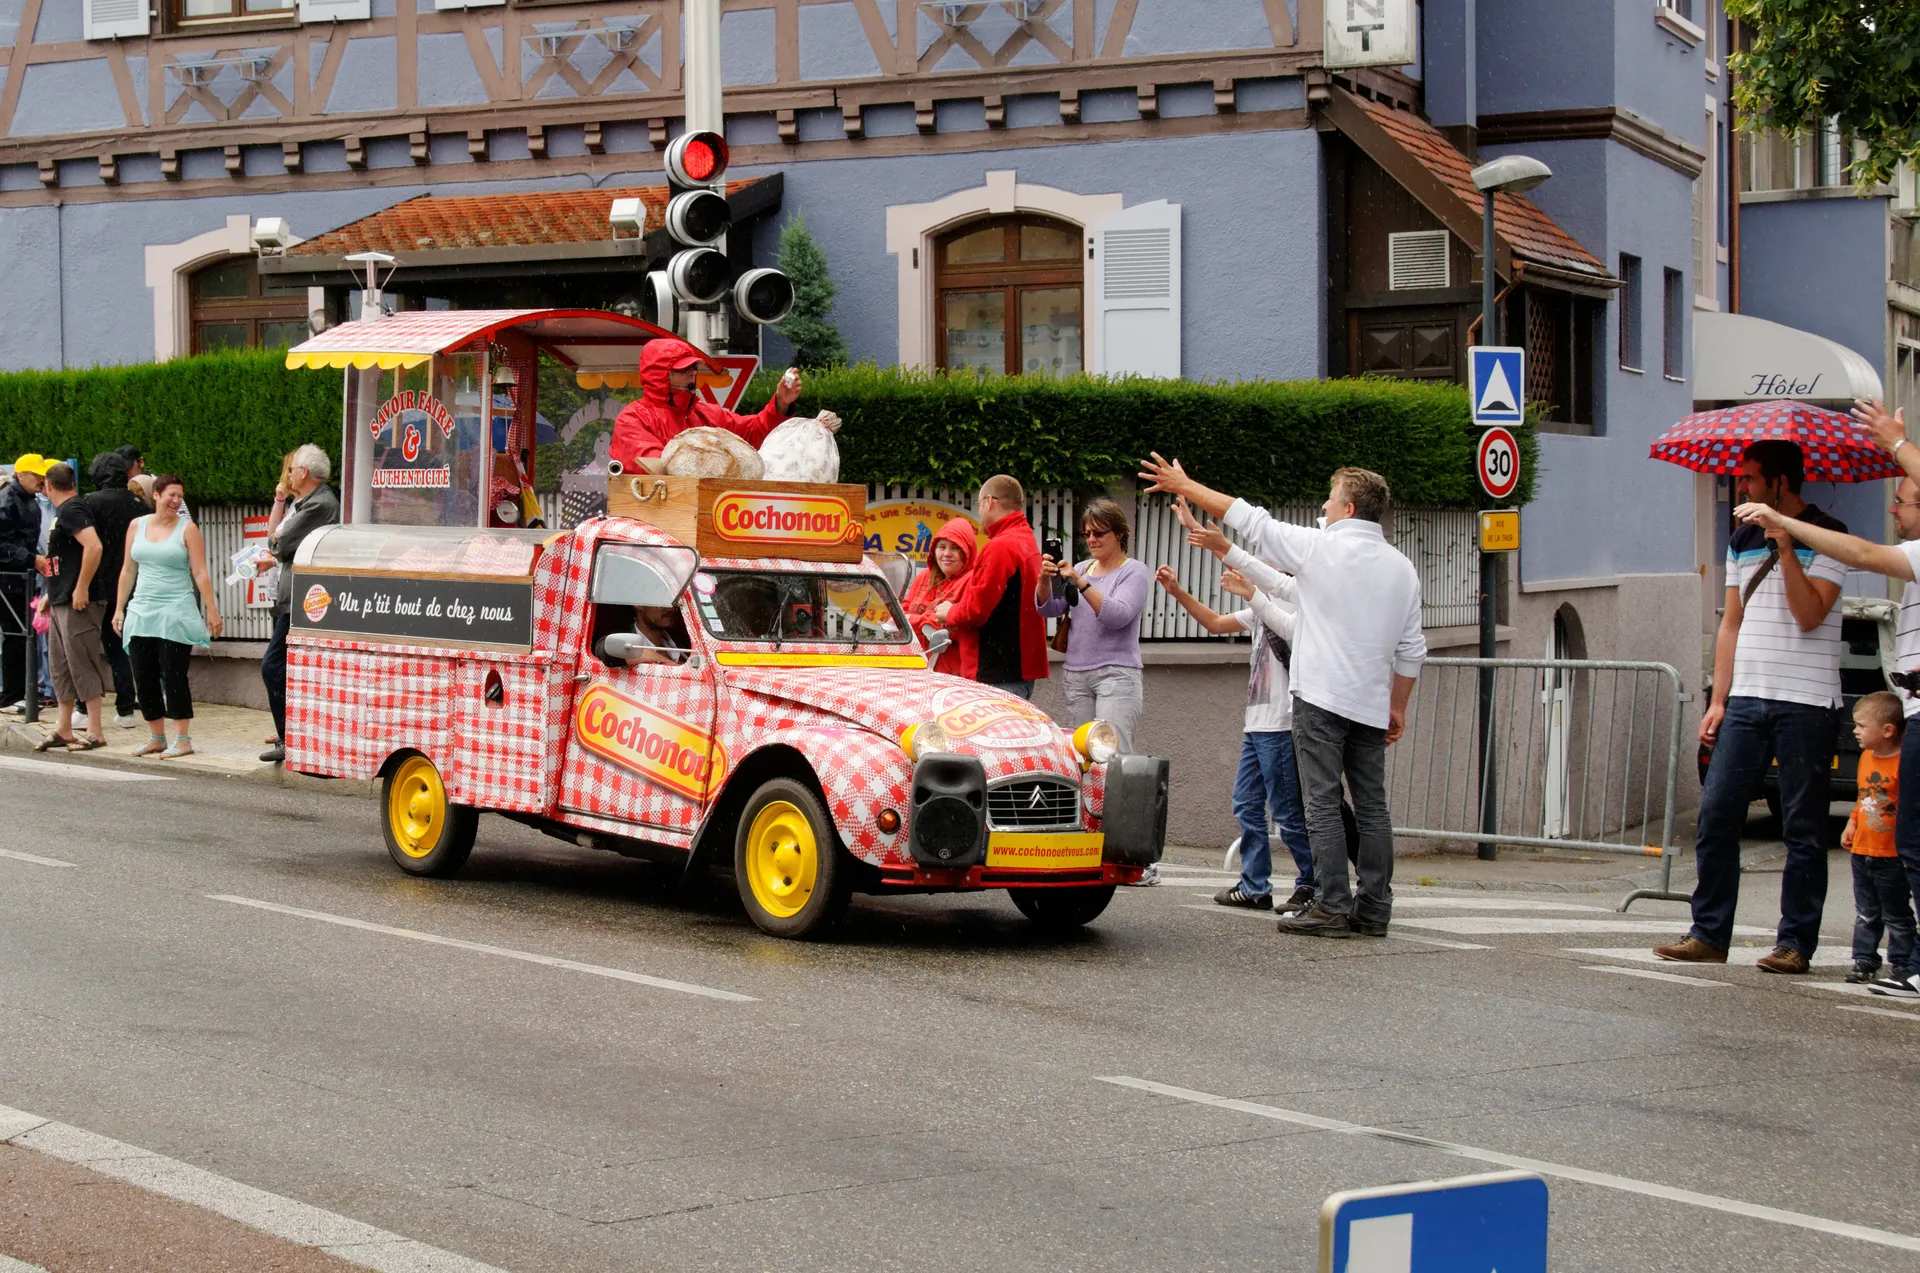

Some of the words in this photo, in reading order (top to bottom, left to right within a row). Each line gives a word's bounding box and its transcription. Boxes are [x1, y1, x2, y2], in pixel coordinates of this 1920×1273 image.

[1744, 373, 1823, 396] Hôtel
[370, 390, 415, 440] SAVOIR
[417, 390, 456, 440] FAIRE
[402, 424, 421, 462] &
[371, 463, 450, 488] AUTHENTICITÉ
[1488, 448, 1511, 477] 30
[721, 503, 841, 533] Cochonou
[880, 508, 899, 519] une
[904, 505, 932, 517] Salle
[936, 510, 950, 521] de
[895, 532, 932, 553] SIL
[339, 591, 360, 612] Un
[362, 592, 390, 618] p'tit
[395, 595, 421, 616] bout
[426, 596, 442, 617] de
[447, 598, 476, 625] chez
[480, 604, 514, 622] nous
[584, 697, 715, 785] Cochonou
